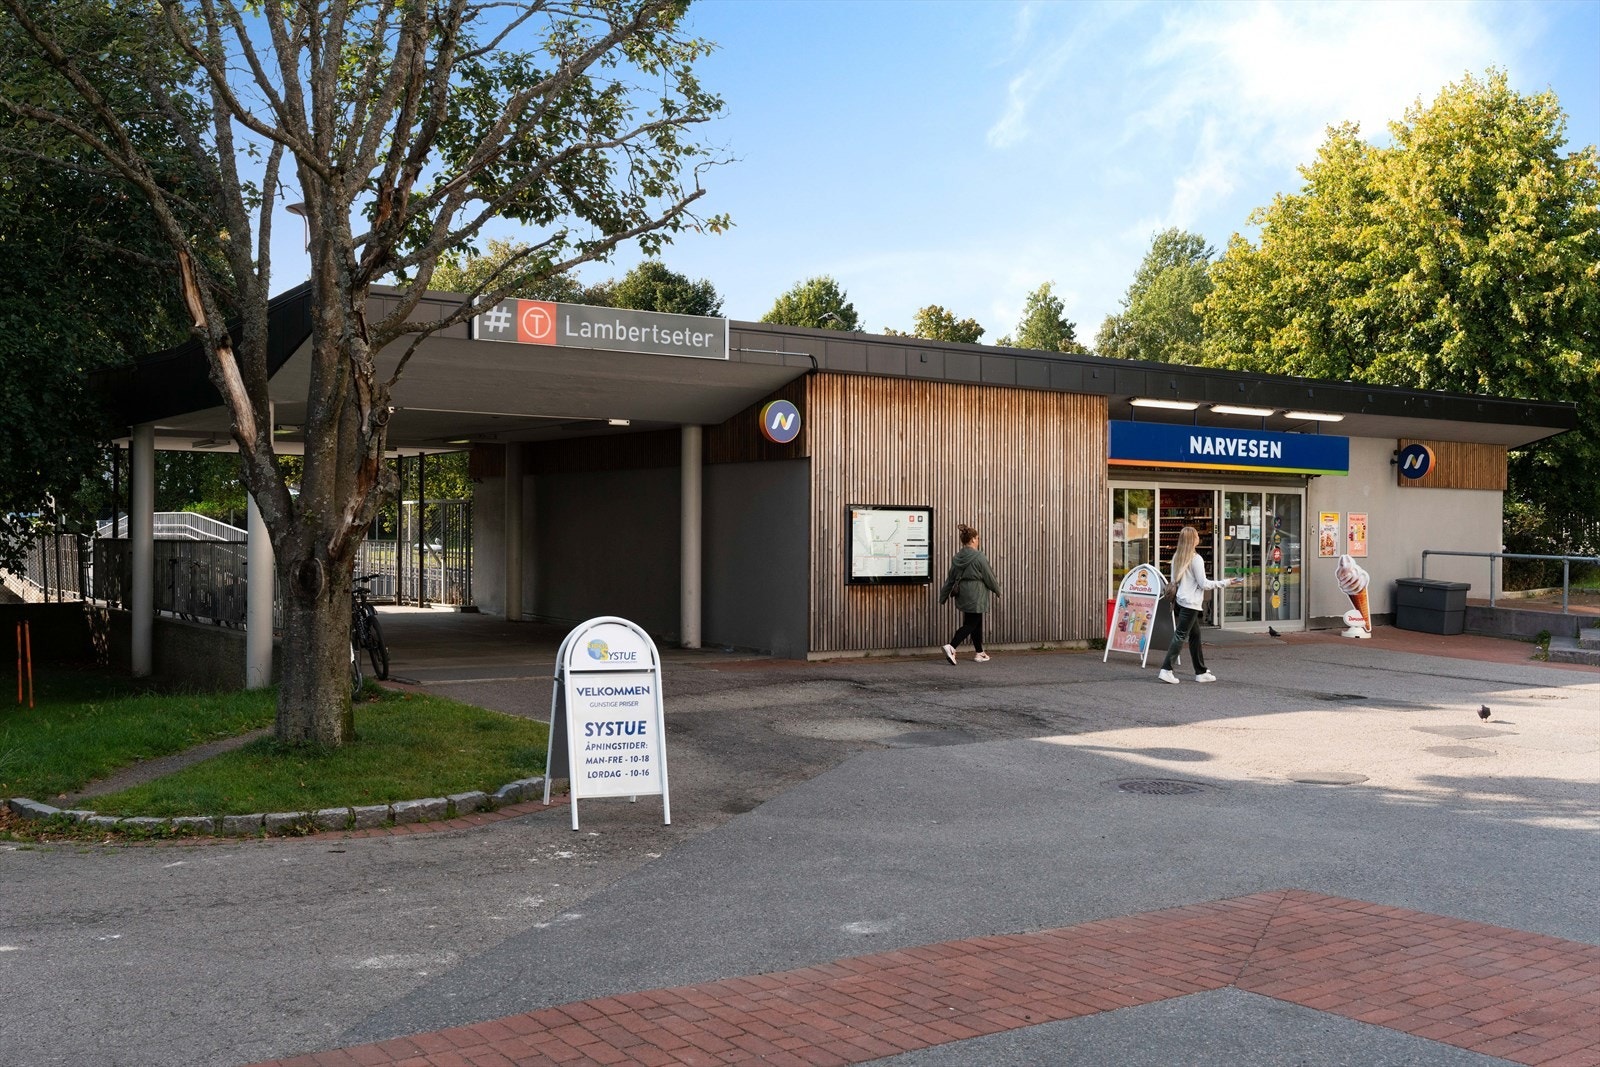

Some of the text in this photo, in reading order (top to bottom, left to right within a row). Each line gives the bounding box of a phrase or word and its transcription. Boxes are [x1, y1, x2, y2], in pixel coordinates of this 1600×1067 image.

[565, 315, 714, 348] Lambertseter
[1189, 435, 1282, 459] NARVESEN
[576, 686, 650, 697] VELKOMMEN
[585, 720, 647, 737] SYSTUE
[585, 741, 648, 751] ÅPNINGSTIDER:
[585, 756, 623, 764] MAN-FRE
[630, 755, 650, 763] 10-18
[630, 769, 650, 777] 10-16
